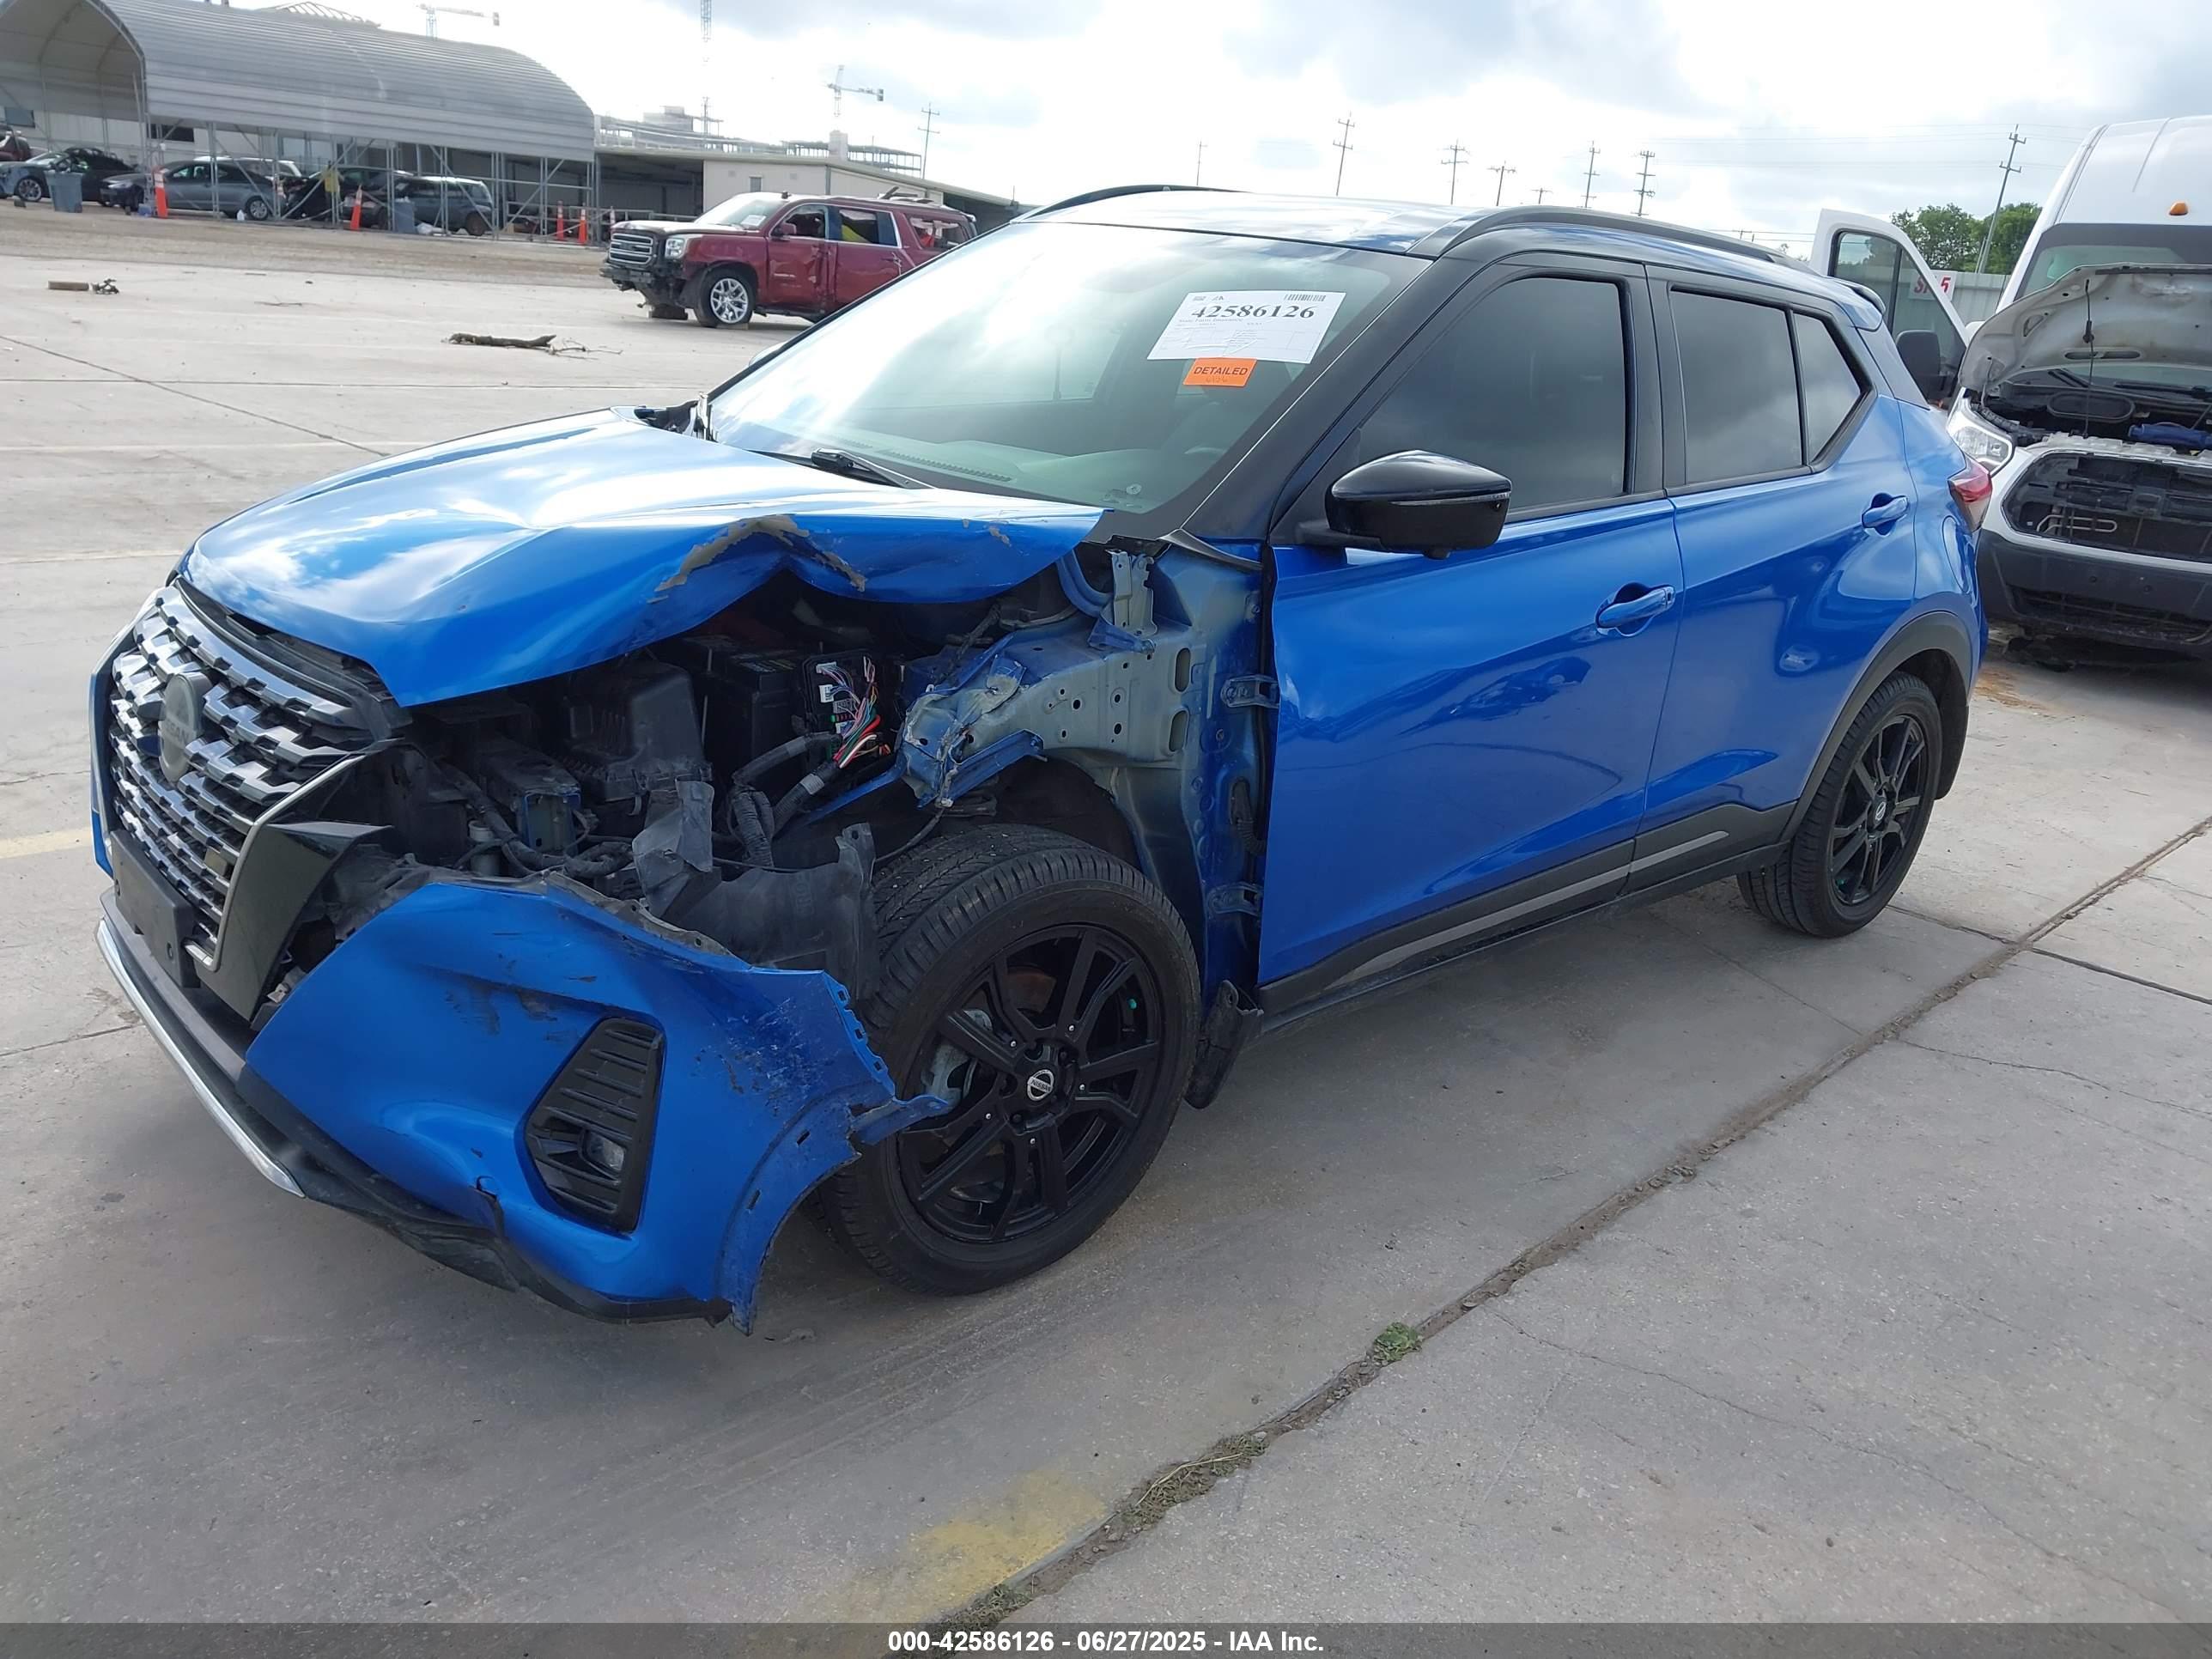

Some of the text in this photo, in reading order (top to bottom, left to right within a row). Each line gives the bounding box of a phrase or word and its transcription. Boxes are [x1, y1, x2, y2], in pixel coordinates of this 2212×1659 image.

[1941, 276, 1951, 293] 5
[1191, 305, 1318, 319] 42586126
[1194, 366, 1249, 375] DETAILED
